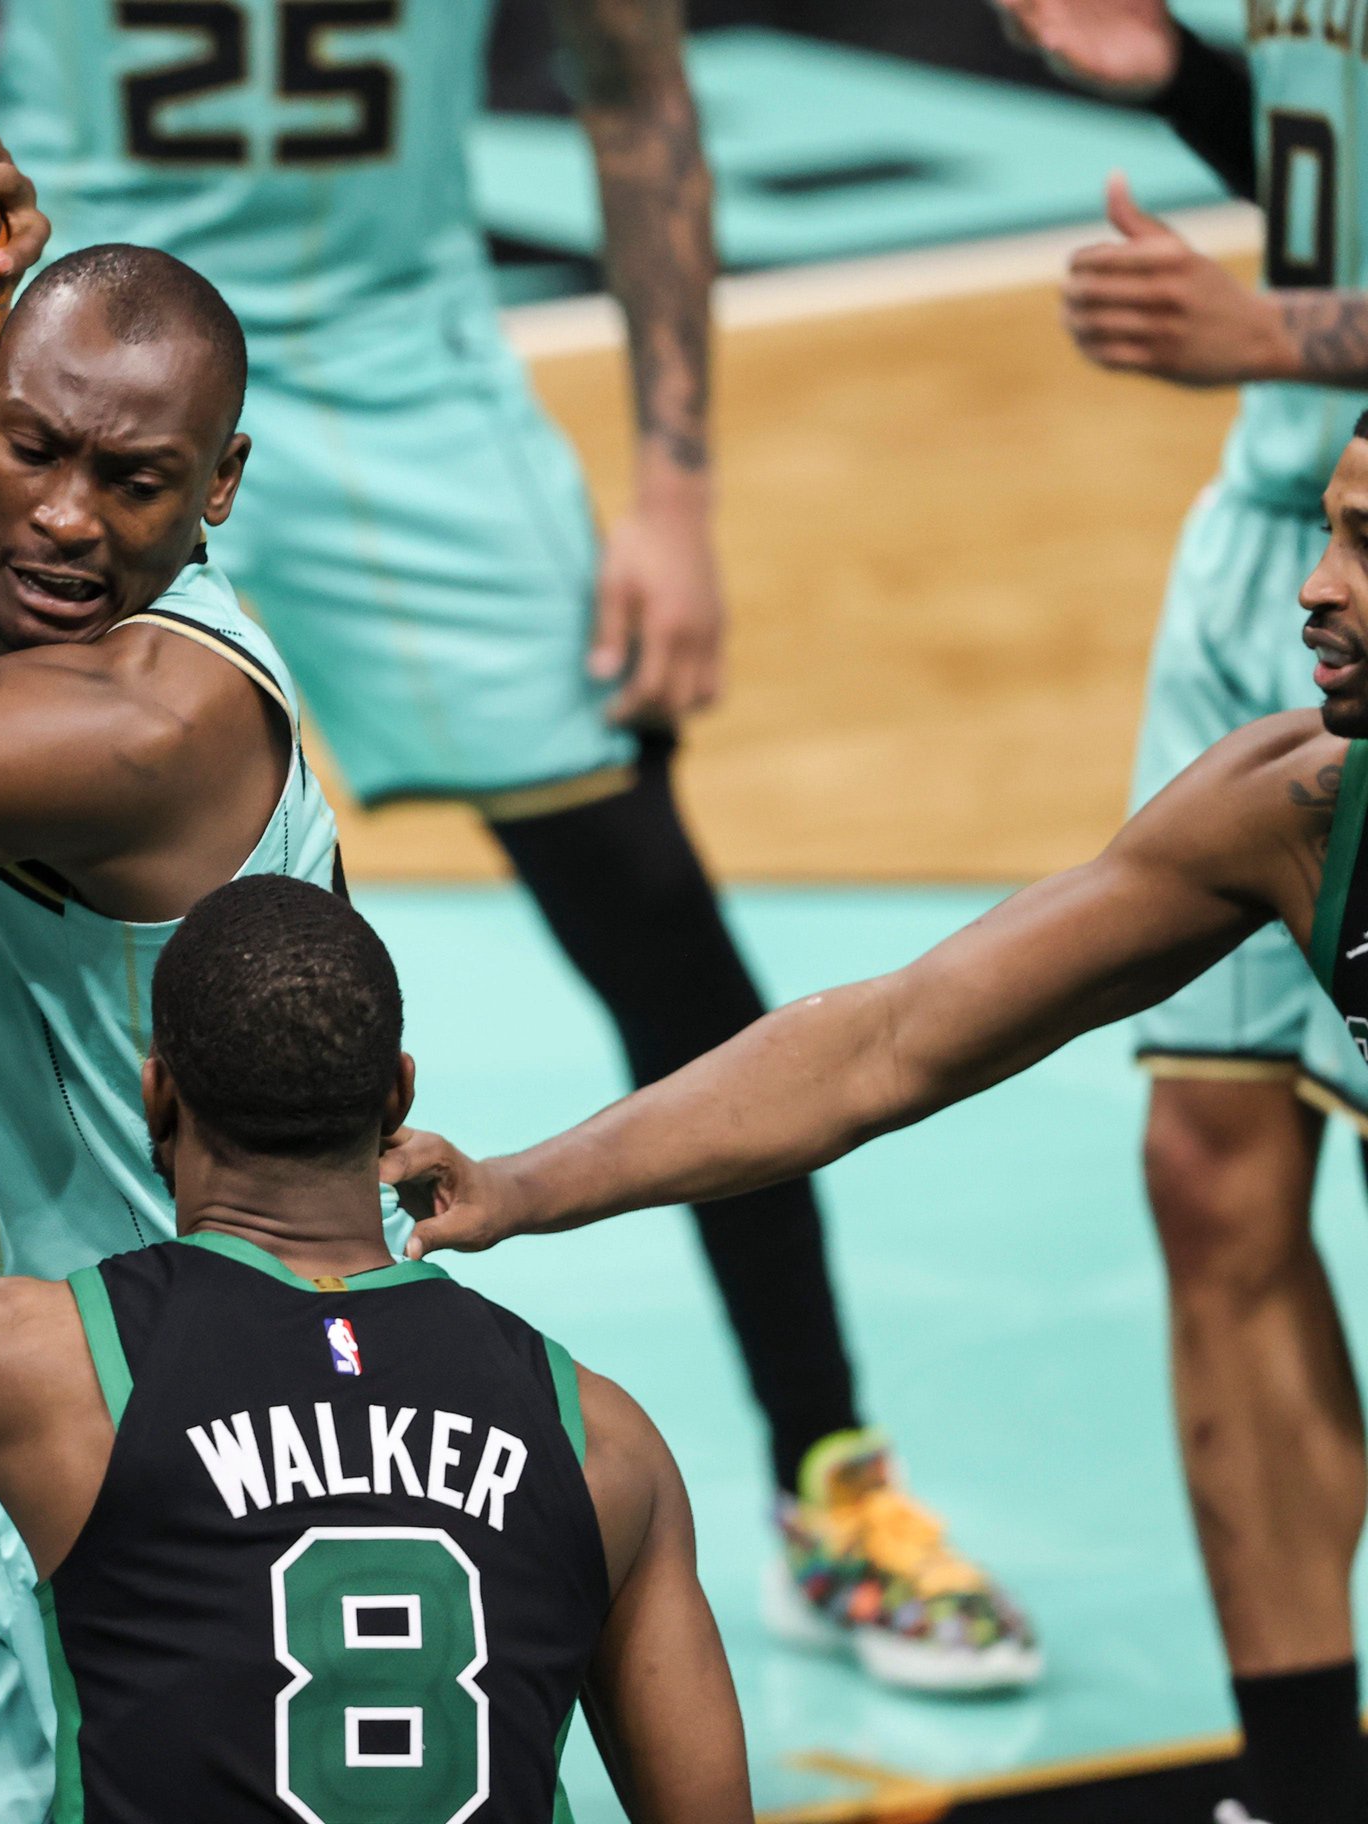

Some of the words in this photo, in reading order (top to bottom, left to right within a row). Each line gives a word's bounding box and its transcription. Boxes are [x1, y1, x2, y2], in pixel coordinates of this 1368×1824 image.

[115, 0, 400, 164] 25
[186, 1401, 529, 1532] WALKER
[270, 1526, 490, 1824] 8
